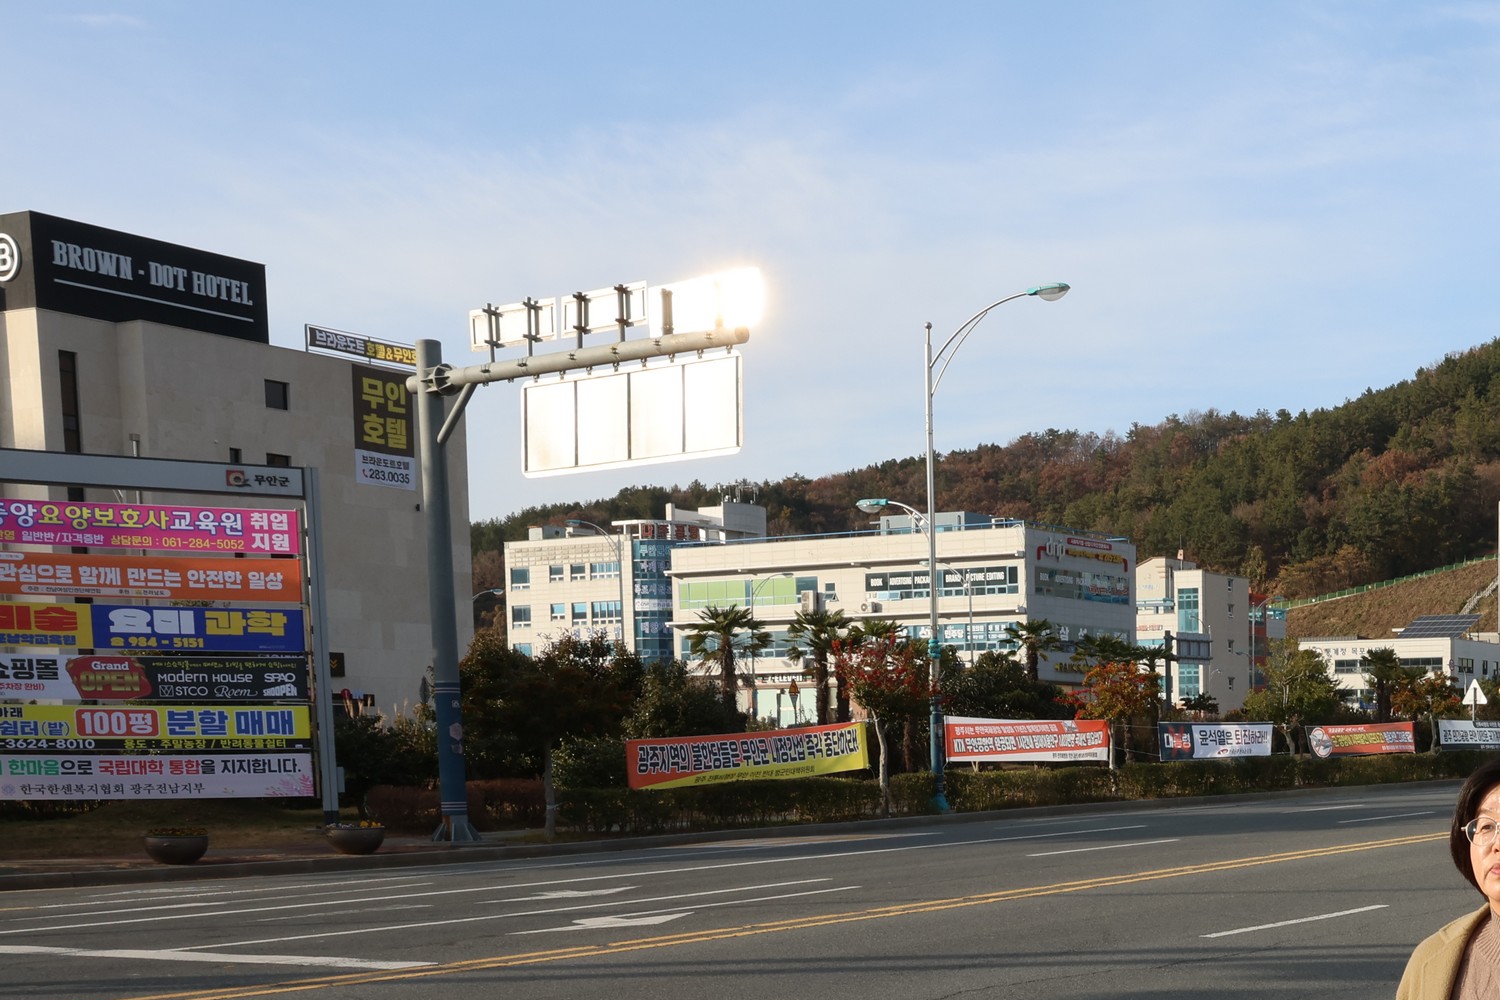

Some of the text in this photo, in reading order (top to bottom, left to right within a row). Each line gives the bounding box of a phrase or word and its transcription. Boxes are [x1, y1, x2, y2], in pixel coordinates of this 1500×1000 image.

[51, 239, 133, 281] BROWN
[149, 262, 187, 292] DOT
[192, 271, 253, 306] HOTEL
[315, 329, 365, 354] 브라운도트
[362, 376, 406, 414] 무인
[362, 413, 408, 449] 호텔
[361, 455, 410, 471] 브라운도트호텔
[254, 474, 290, 487] 무안군
[369, 468, 410, 484] 283.0035
[250, 512, 289, 530] 취업
[111, 535, 153, 546] 상담문의
[162, 536, 245, 550] 061-284-5052
[251, 532, 290, 551] 지원
[78, 565, 121, 585] 함께
[127, 567, 182, 588] 만드는
[187, 569, 242, 589] 안전한
[248, 571, 283, 590] 일상
[966, 572, 985, 581] PCTURE
[205, 610, 287, 636] 과학
[91, 660, 130, 671] Grand
[80, 671, 140, 692] OPEN
[264, 672, 296, 683] SPAO
[175, 686, 209, 696] STCO
[81, 711, 152, 735] 100평
[166, 709, 229, 736] 분할
[234, 709, 295, 736] 매매
[123, 739, 147, 749] 용도
[160, 739, 206, 749] 주말농장
[1199, 729, 1233, 746] 윤석열은
[637, 727, 860, 775] 광주지역의 불한당들은 무안군 내정간섭 즉각 중단하라!
[8, 758, 301, 776] 한마음으로 국립대학 통합을 지지합니다.
[20, 782, 205, 796] 한국한센복지협회 광주전남지부
